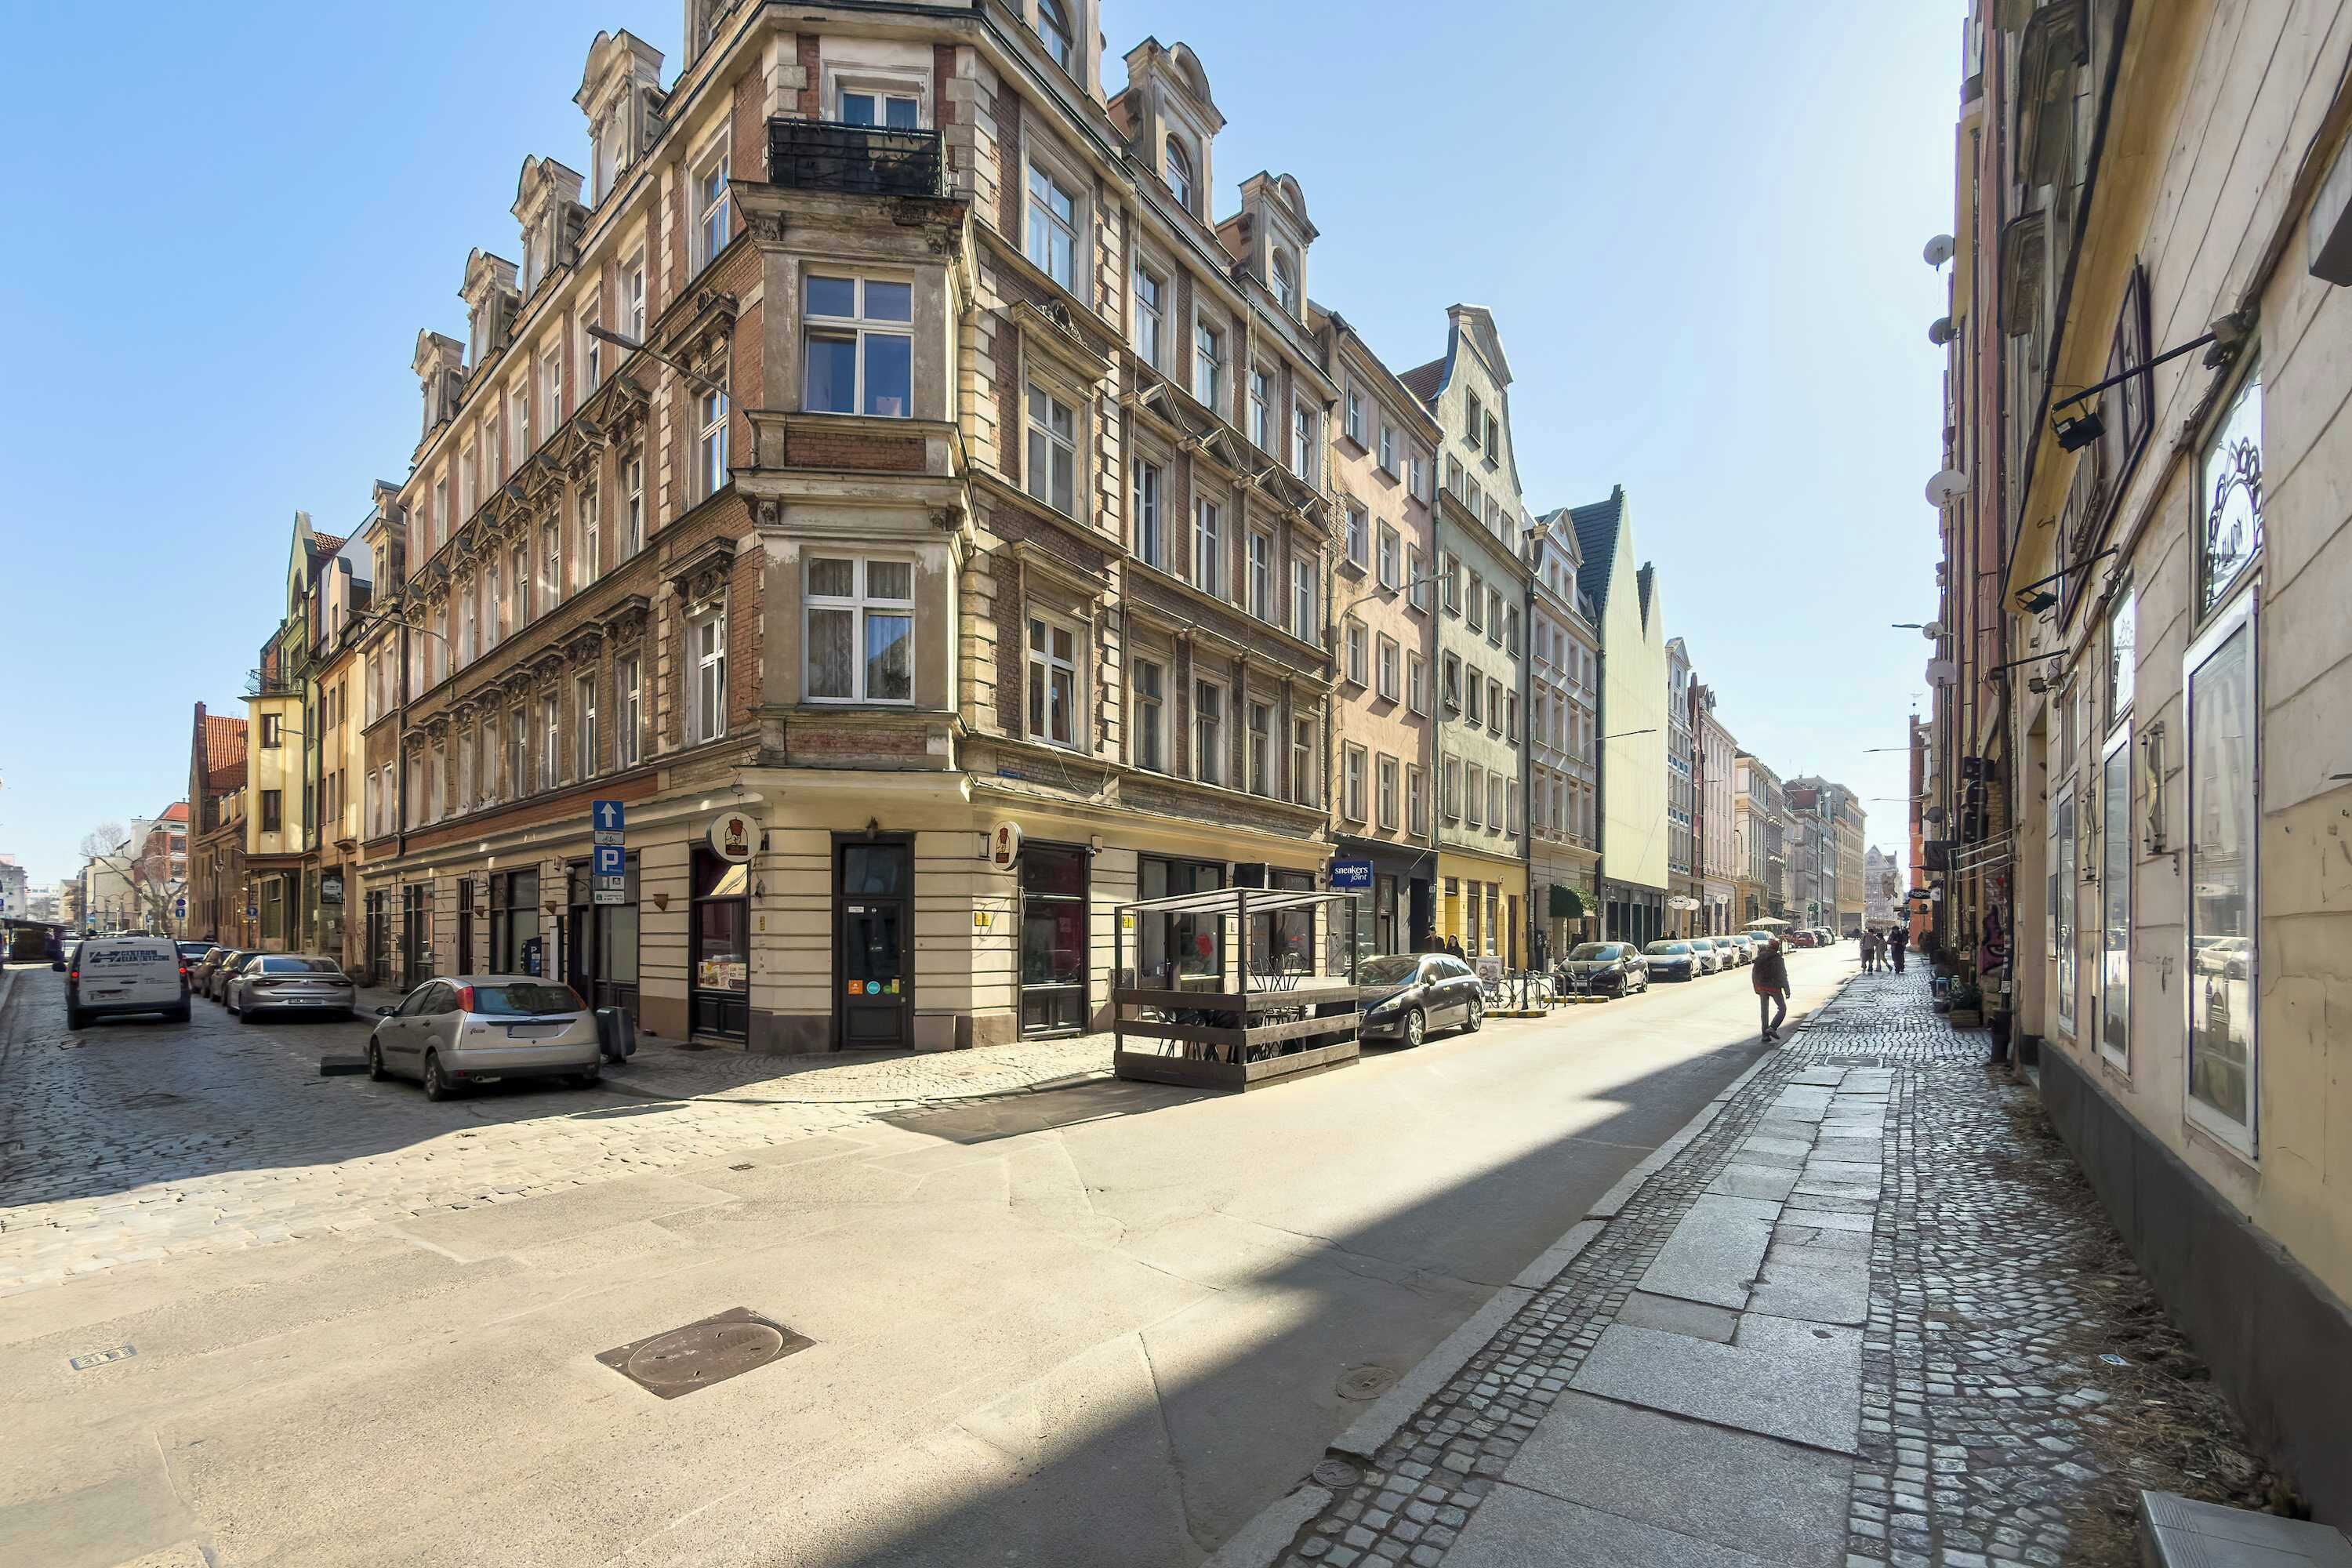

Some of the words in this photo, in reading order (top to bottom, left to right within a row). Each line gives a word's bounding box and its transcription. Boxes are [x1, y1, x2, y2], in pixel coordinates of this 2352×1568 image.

[601, 849, 619, 872] P
[1334, 865, 1369, 876] sneakers
[1350, 873, 1367, 883] joint
